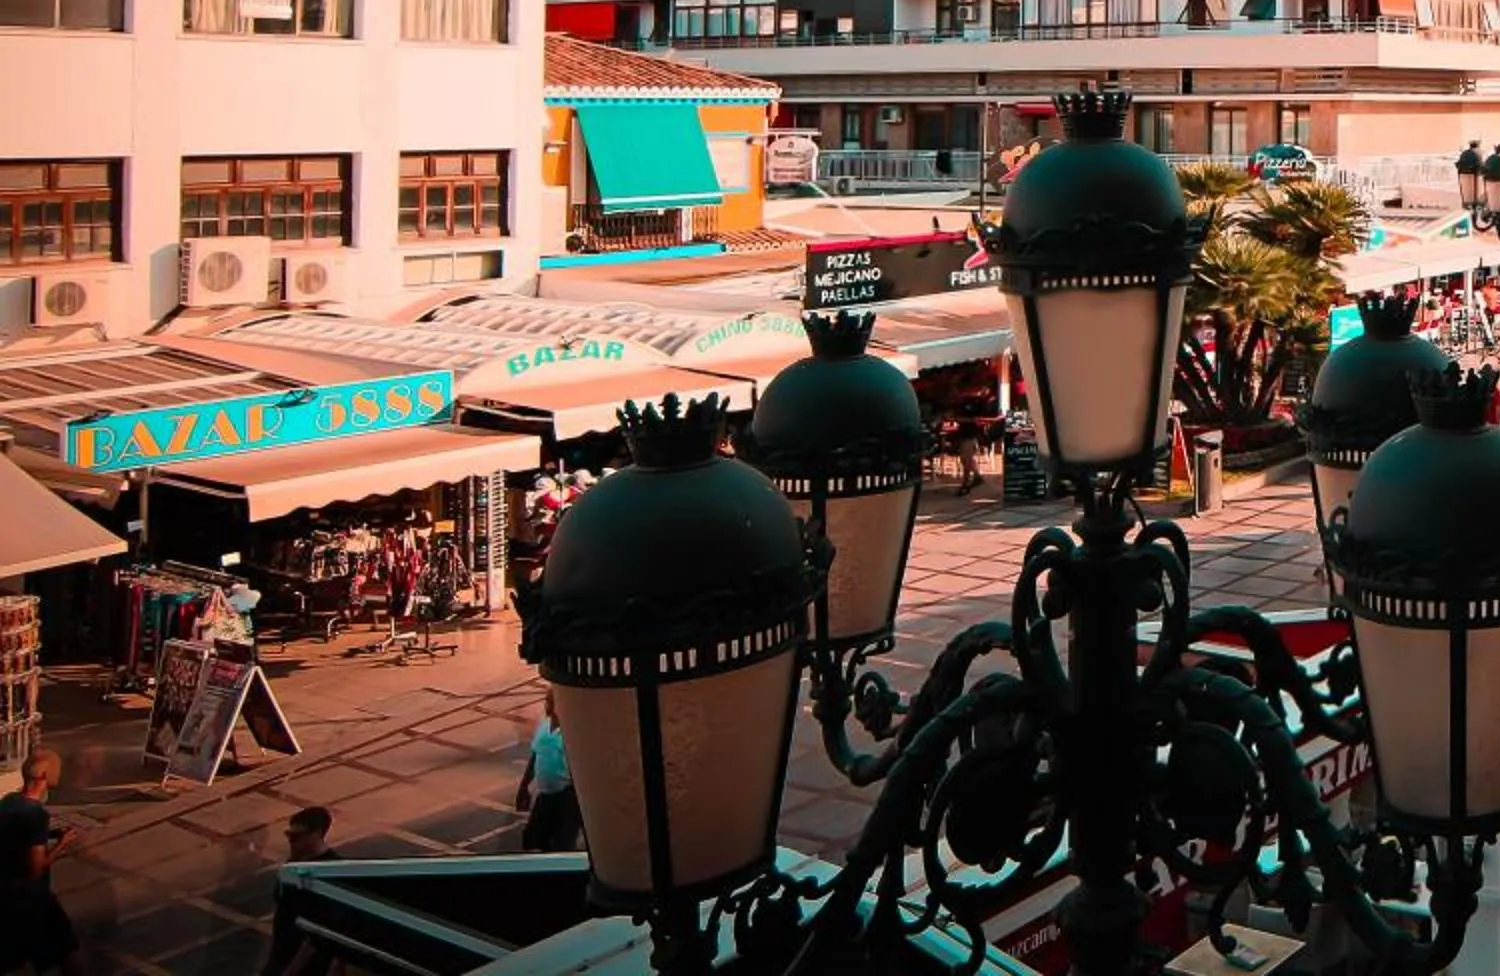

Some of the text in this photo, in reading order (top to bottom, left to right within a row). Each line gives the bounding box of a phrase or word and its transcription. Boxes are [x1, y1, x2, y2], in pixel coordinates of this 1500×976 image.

[826, 252, 871, 269] PIZZAS
[814, 267, 881, 287] MEJICANO
[951, 270, 977, 288] FISH
[821, 285, 875, 304] PAELLAS
[695, 319, 753, 353] CHINO
[506, 339, 625, 378] BAZAR
[75, 379, 445, 470] BAZAR 5888
